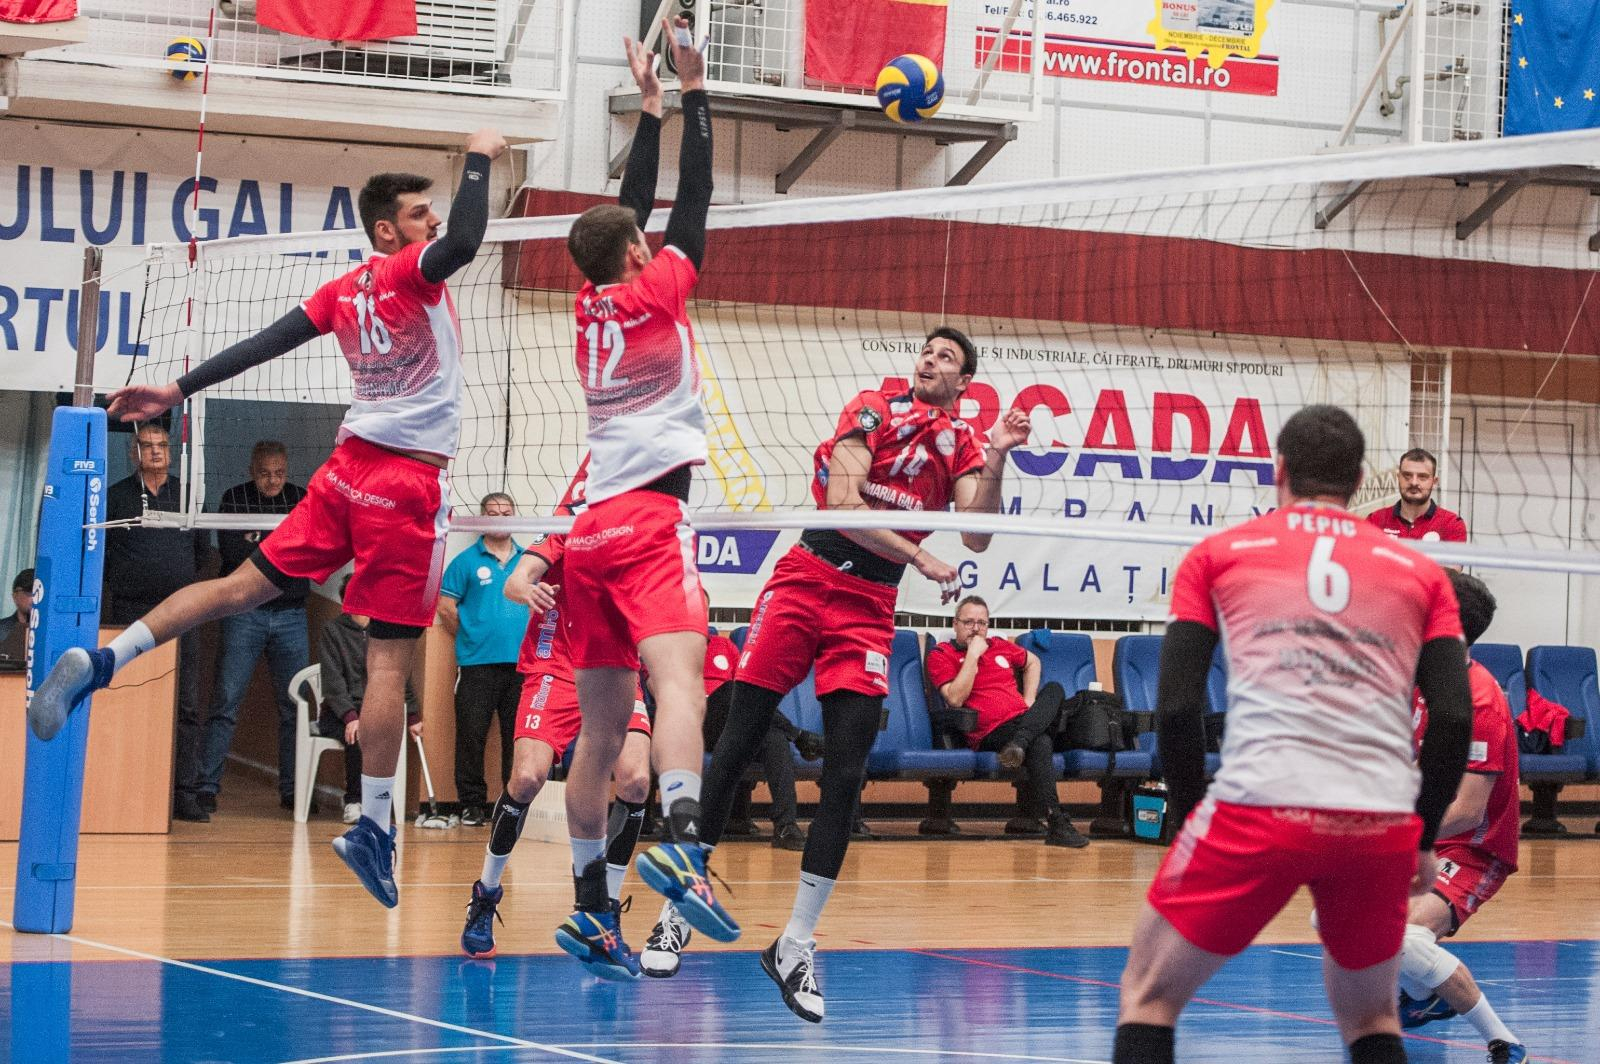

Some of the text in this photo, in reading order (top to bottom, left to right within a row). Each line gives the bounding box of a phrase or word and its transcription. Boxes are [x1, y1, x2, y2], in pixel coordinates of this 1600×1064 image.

[1162, 2, 1196, 12] BONUS
[352, 290, 393, 355] 16
[585, 319, 629, 389] 12
[1006, 349, 1090, 365] INDUSTRIALE,
[1116, 354, 1164, 369] FERATE,
[1167, 357, 1223, 373] DRUMURI
[1240, 363, 1283, 377] PODURI
[880, 377, 1275, 486] RCADA
[889, 442, 929, 483] 14
[364, 494, 396, 509] DESIGN
[602, 525, 633, 539] DESIGN
[1306, 535, 1351, 614] 6
[536, 609, 559, 659] amiro
[525, 714, 541, 730] 13
